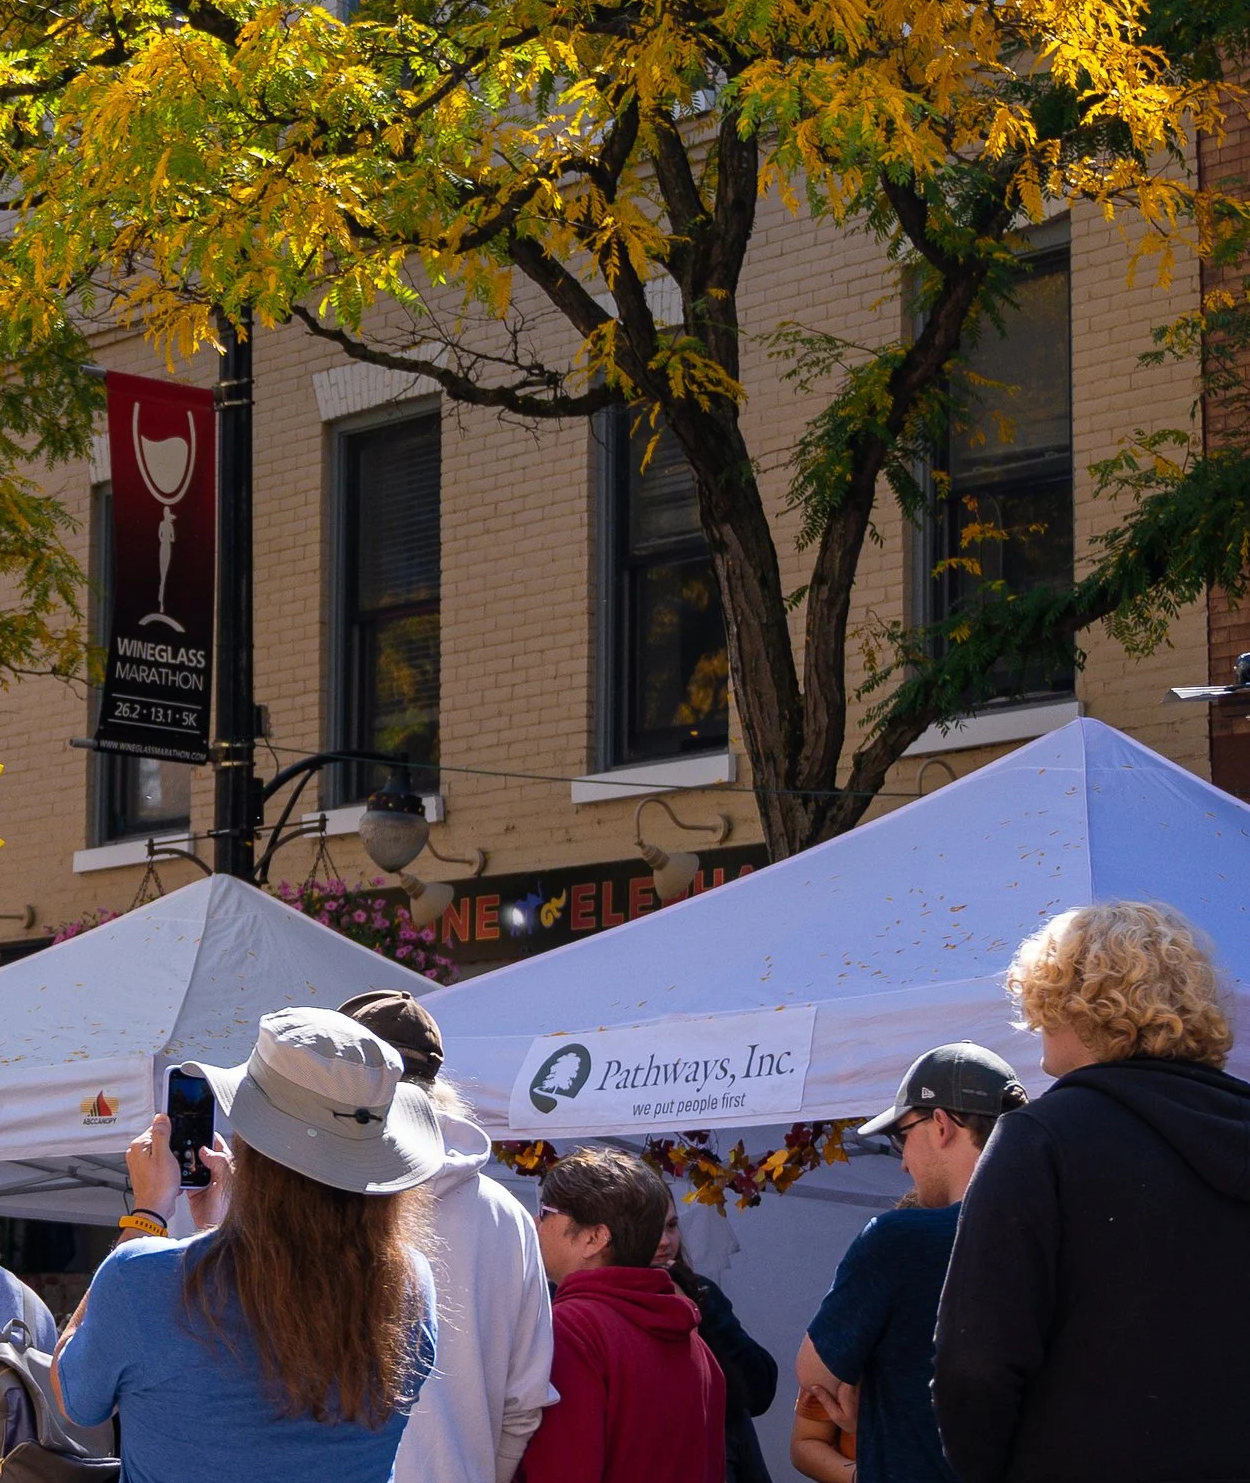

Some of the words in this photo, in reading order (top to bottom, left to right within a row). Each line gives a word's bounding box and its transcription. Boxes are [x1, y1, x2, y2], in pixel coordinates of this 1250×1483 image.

[116, 636, 206, 668] WINEGLASS
[114, 661, 204, 691] MARATHON
[114, 701, 141, 719] 26.2
[150, 706, 172, 723] 13.1
[181, 711, 198, 727] 5K
[594, 1053, 736, 1094] Pathways,
[741, 1043, 795, 1079] Inc.
[632, 1101, 651, 1116] we
[654, 1098, 675, 1118] put
[677, 1093, 718, 1115] people
[719, 1092, 746, 1109] first
